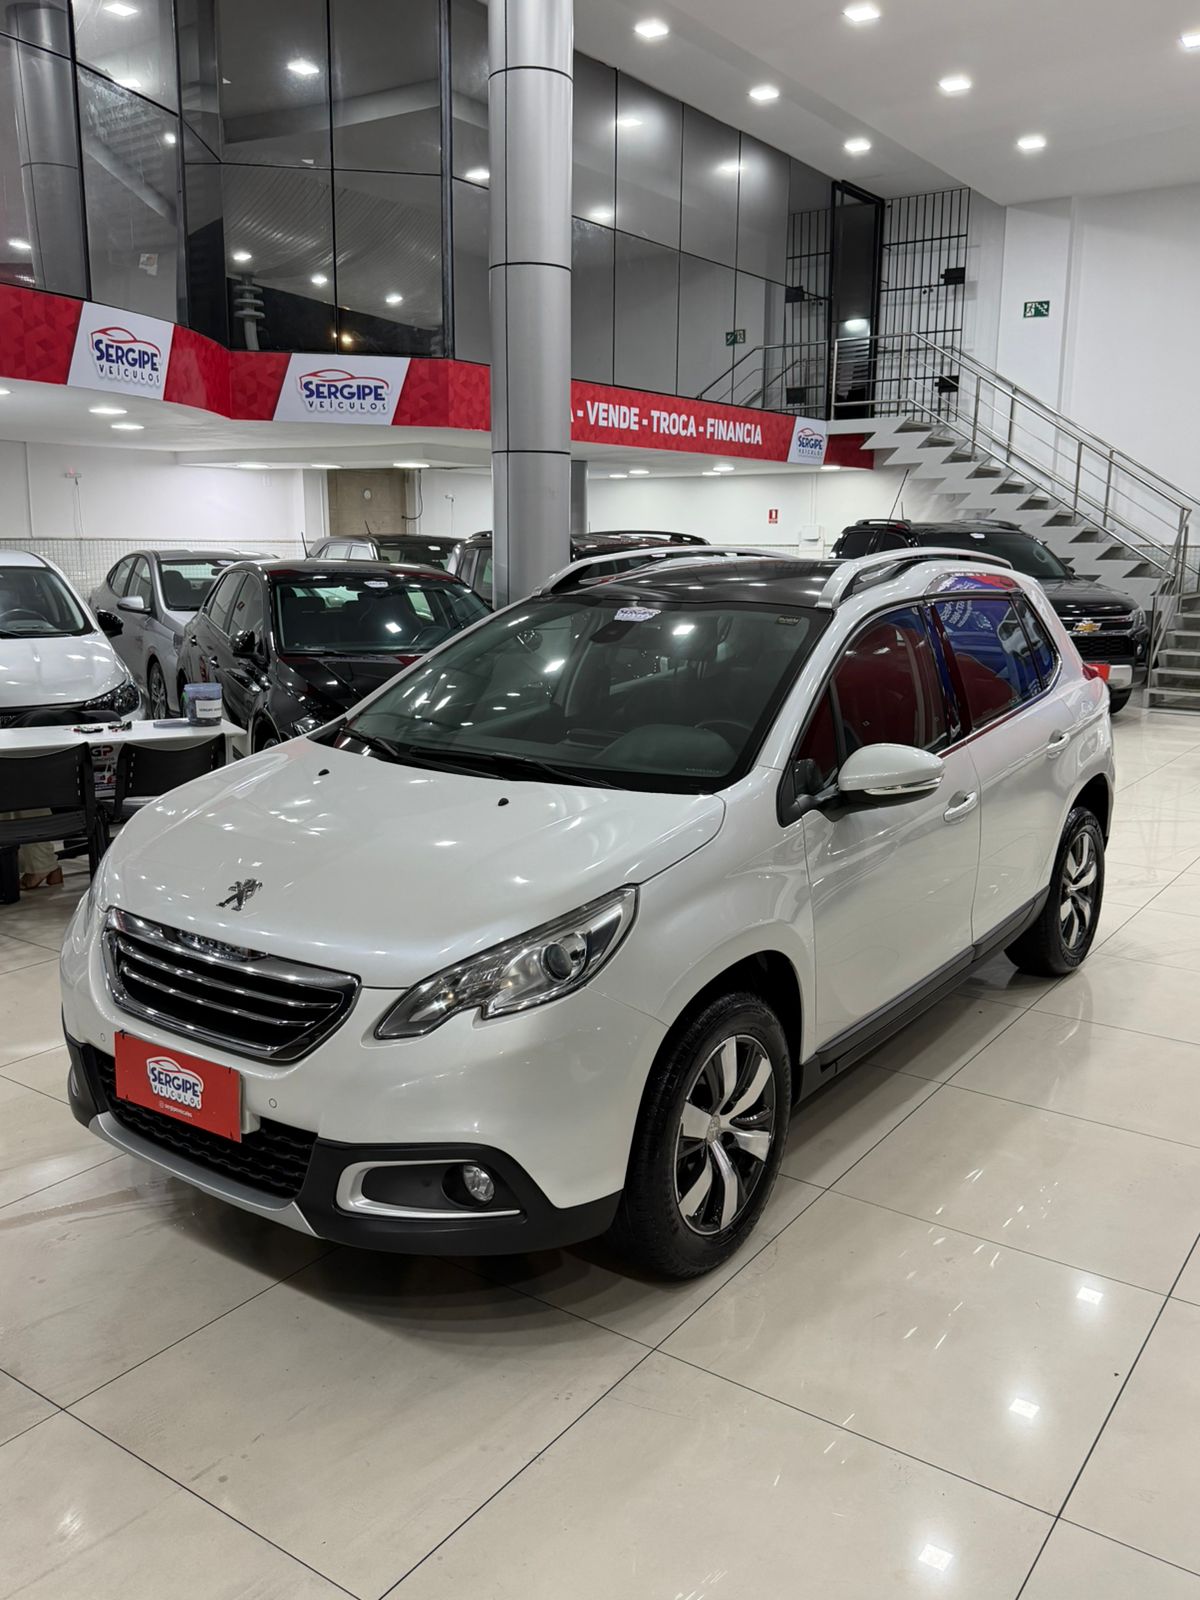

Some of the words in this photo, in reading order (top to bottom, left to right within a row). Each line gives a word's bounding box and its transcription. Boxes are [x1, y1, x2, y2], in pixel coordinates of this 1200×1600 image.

[94, 339, 159, 372] SERGIPE
[99, 364, 160, 384] VEÍCULOS
[303, 380, 386, 401] SERGIPE
[308, 400, 386, 411] VEÍCULOS
[586, 400, 639, 431] VENDE
[650, 410, 697, 438] TROCA
[706, 417, 763, 445] FINANCIA
[798, 435, 823, 450] SERGIPE
[151, 1066, 200, 1098] SERGIPE
